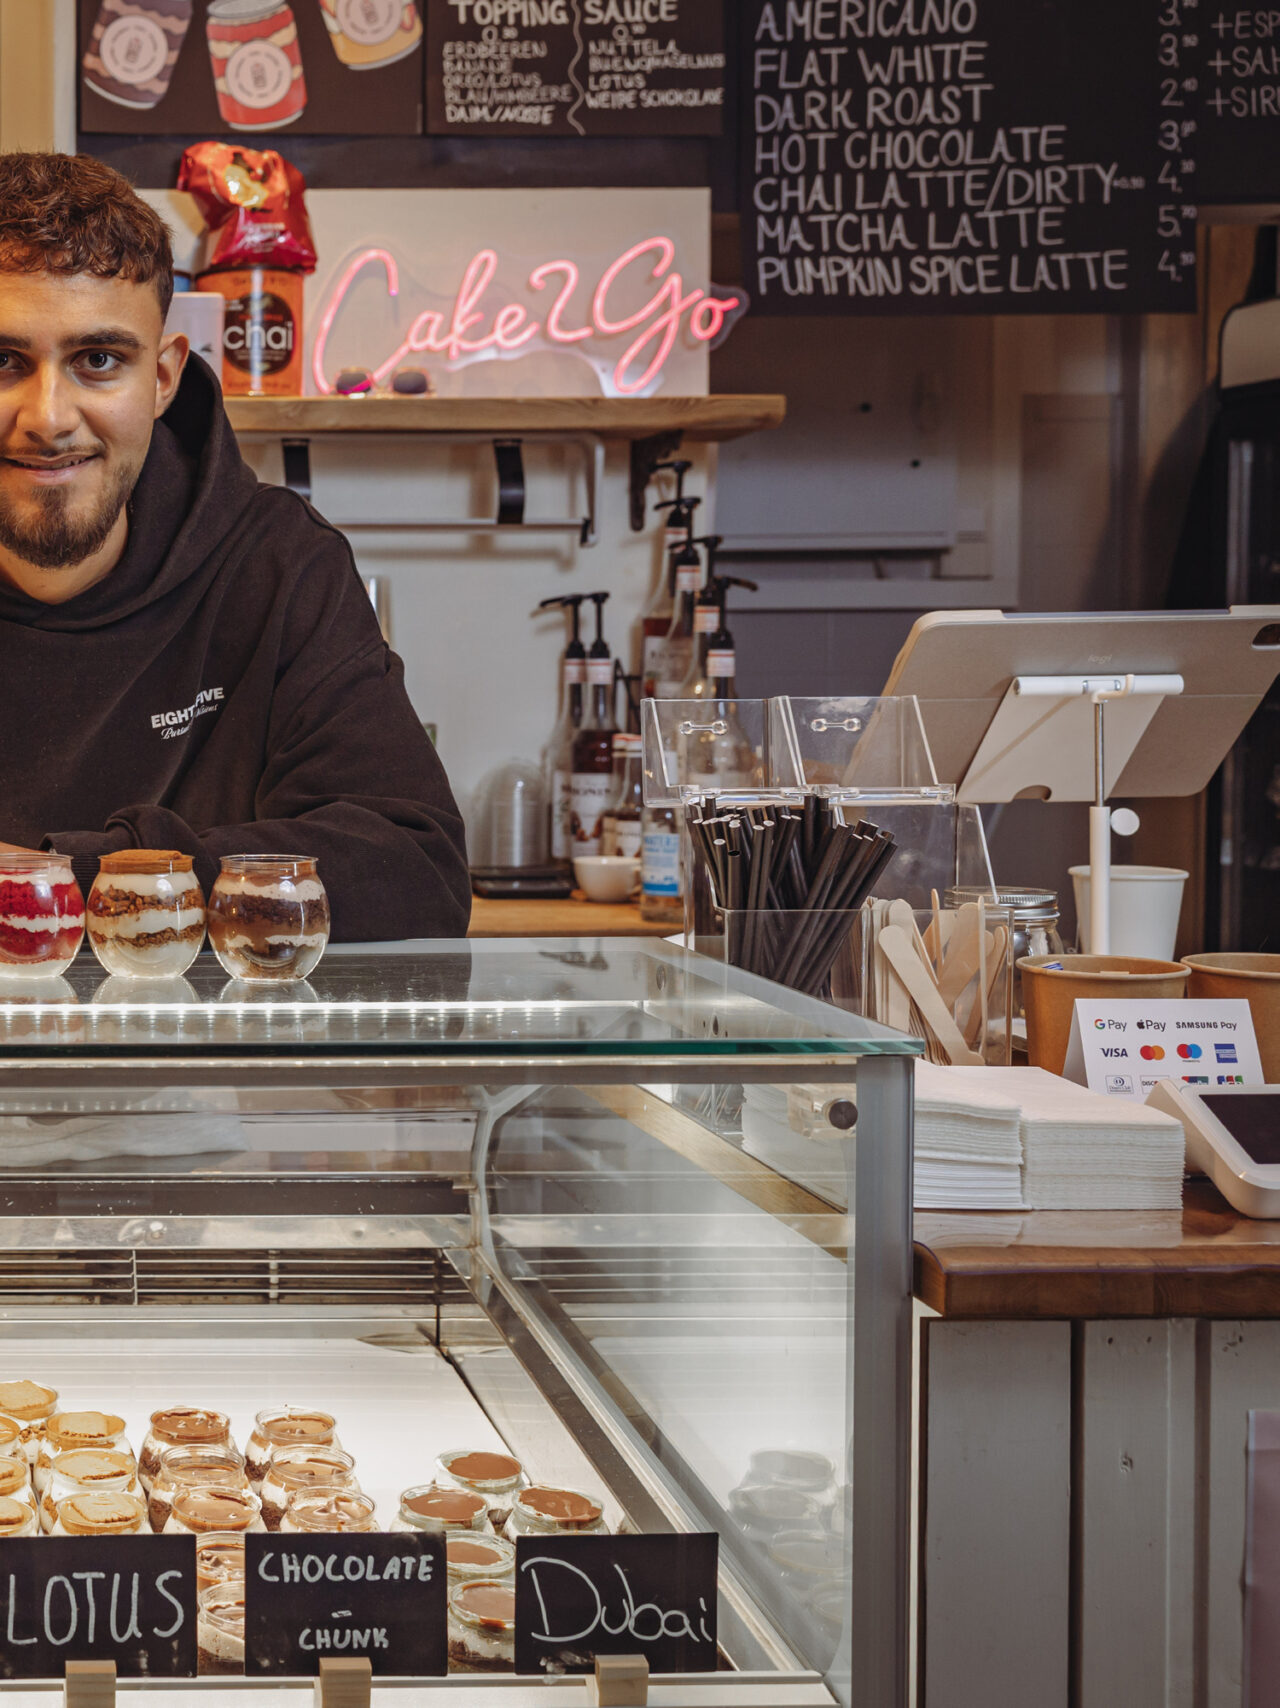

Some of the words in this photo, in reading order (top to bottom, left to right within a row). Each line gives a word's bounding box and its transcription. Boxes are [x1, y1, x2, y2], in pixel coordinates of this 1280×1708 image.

[447, 0, 569, 27] TOPPING
[583, 0, 679, 25] SAUCE
[754, 0, 978, 42] AMERICANO
[442, 41, 548, 60] ERDBEEREN
[753, 48, 849, 89] FLAT
[856, 41, 989, 86] WHITE
[587, 73, 647, 91] LOTUS
[754, 88, 858, 133] DARK
[866, 83, 995, 129] ROAST
[1206, 85, 1280, 118] +SIR
[755, 131, 839, 175] HOT
[843, 125, 1068, 170] CHOCOLATE
[753, 173, 843, 213] CHAI
[853, 162, 1119, 213] LATTE/DIRTY
[756, 213, 918, 253] MATCHA
[926, 206, 1066, 250] LATTE
[757, 255, 904, 297] PUMPKIN
[908, 254, 1004, 297] SPICE
[1008, 249, 1129, 294] LATTE
[223, 319, 294, 350] chai
[1108, 1019, 1128, 1033] Pay
[1146, 1019, 1167, 1033] Pay
[1175, 1021, 1219, 1030] SAMSUNG
[1220, 1021, 1238, 1031] Pay
[1100, 1047, 1129, 1058] VISA
[258, 1552, 434, 1583] CHOCOLATE
[7, 1570, 185, 1646] LOTUS
[520, 1556, 713, 1643] Dubai
[298, 1627, 389, 1650] CHUNK
